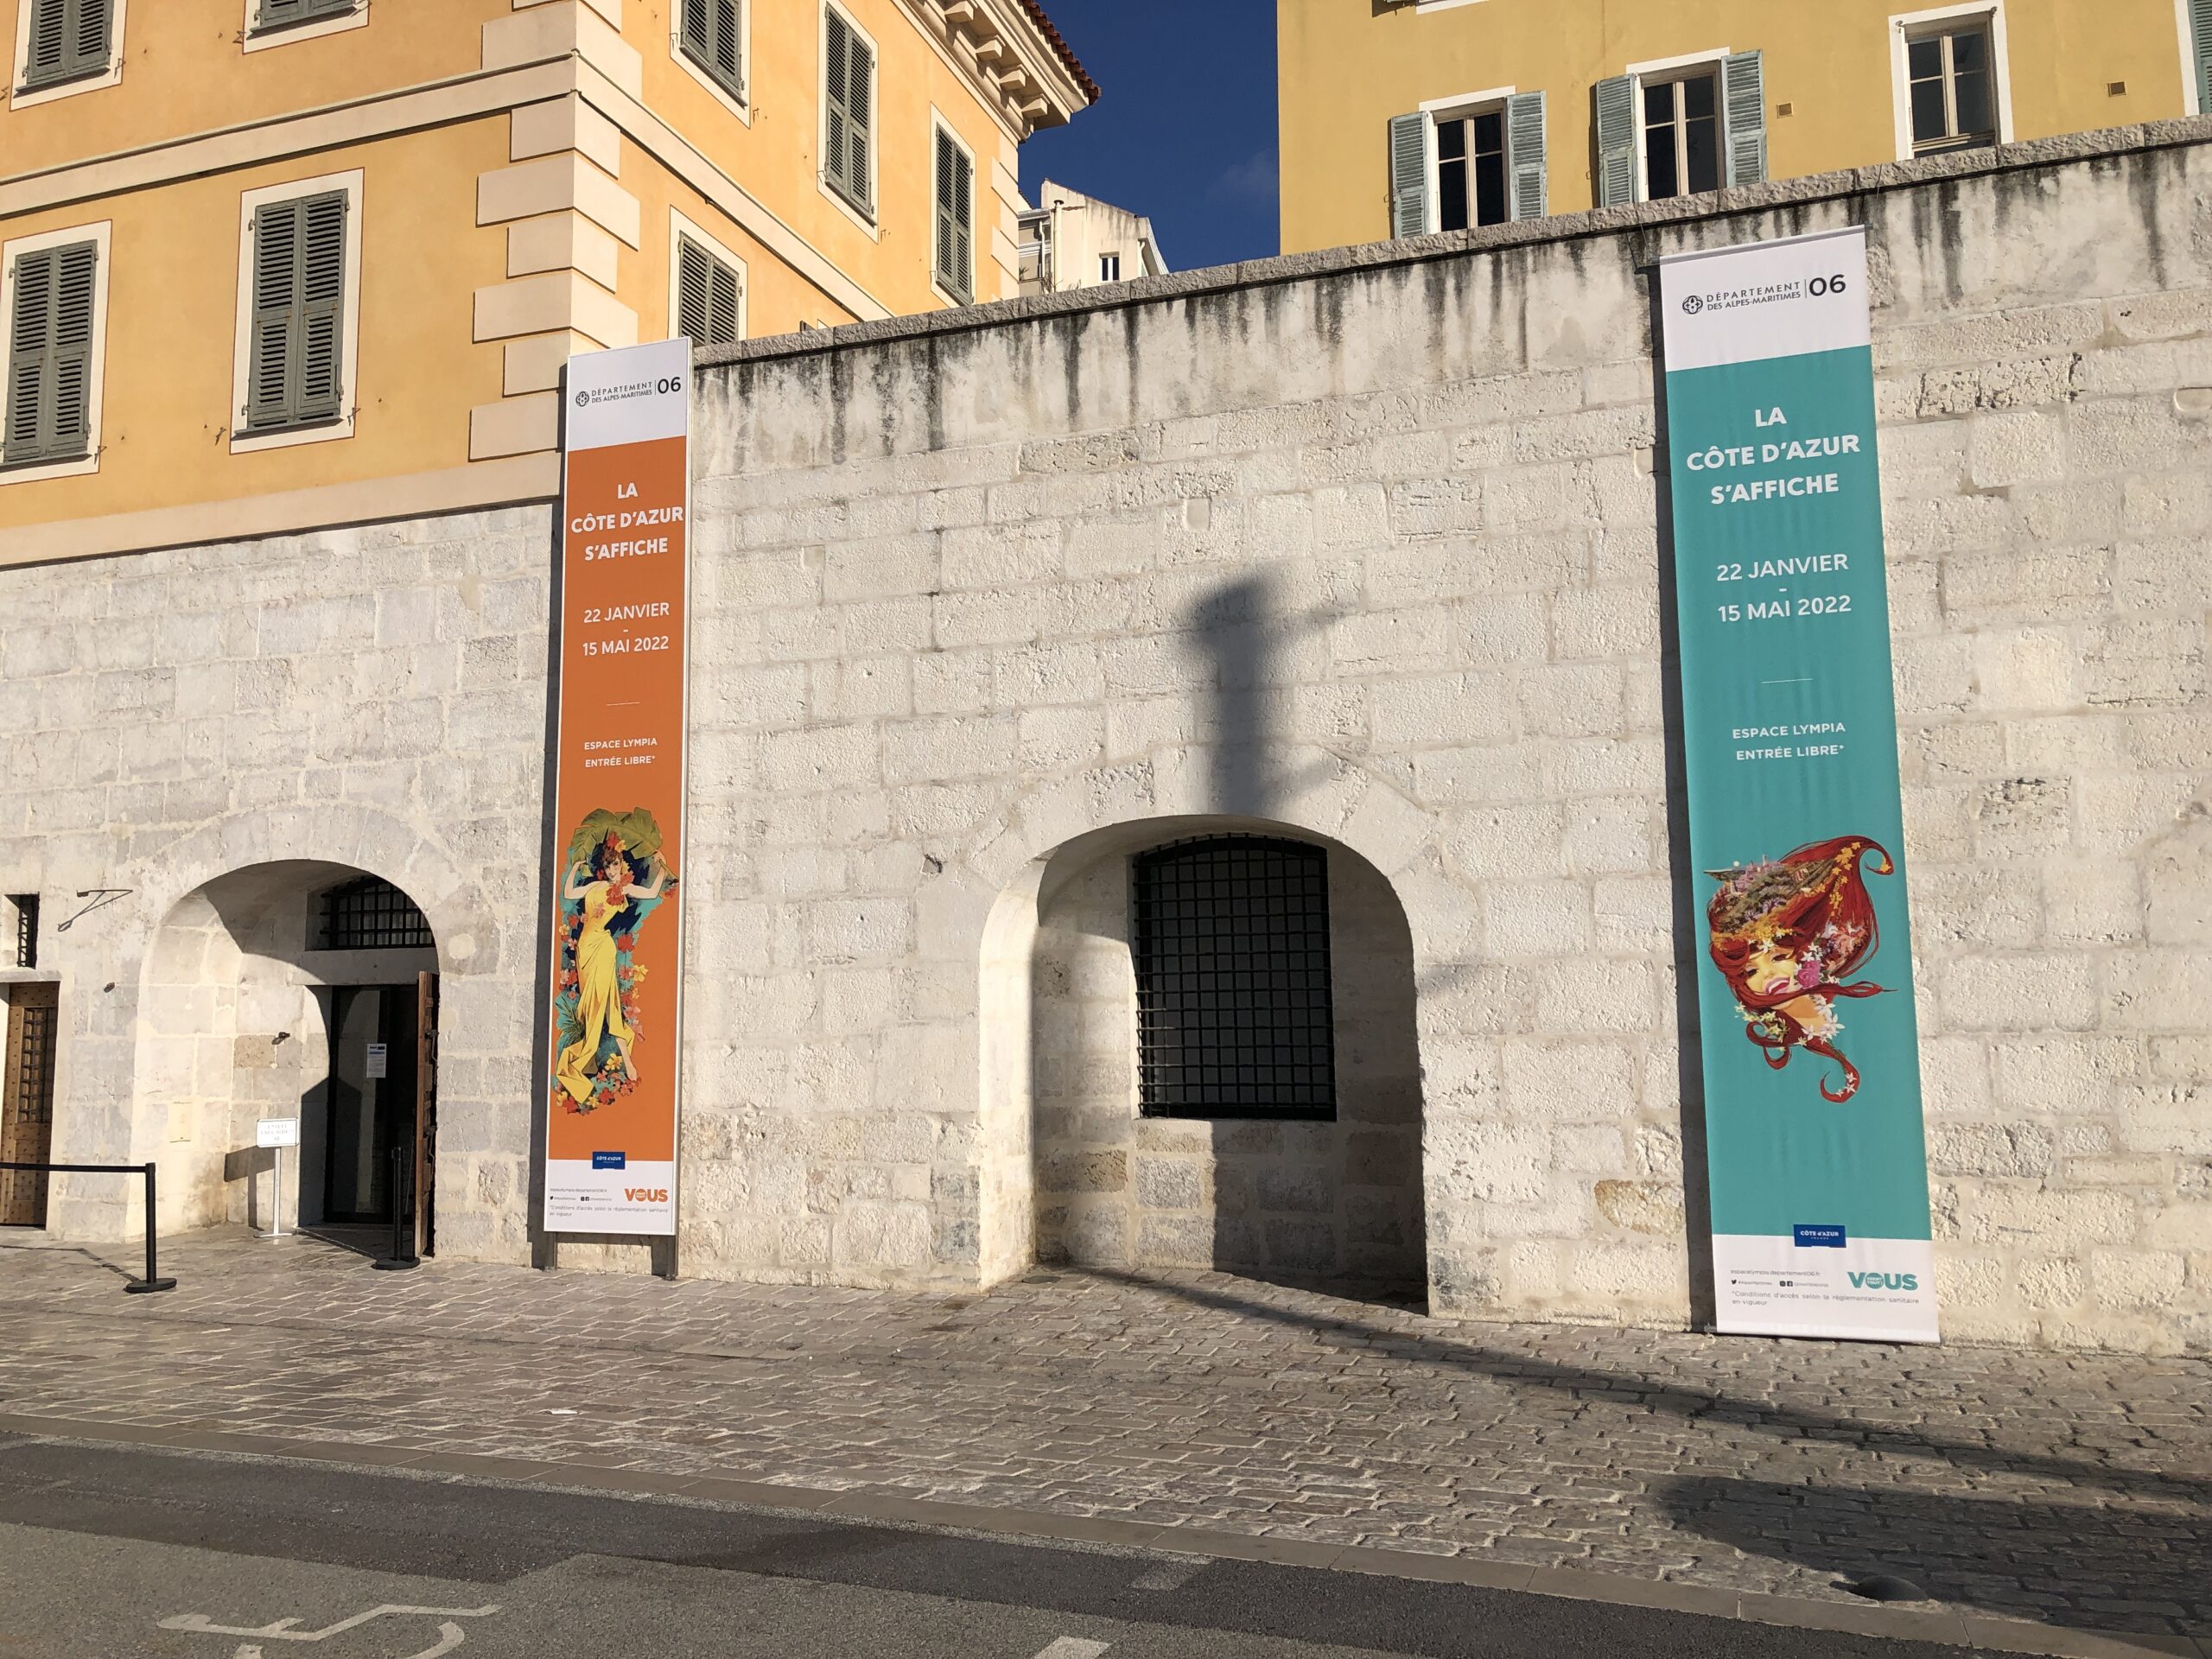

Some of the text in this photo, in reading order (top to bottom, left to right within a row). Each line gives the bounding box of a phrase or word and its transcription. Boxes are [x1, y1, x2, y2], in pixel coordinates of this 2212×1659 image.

[1707, 281, 1801, 302] DÉPARTEMENT
[1808, 274, 1847, 296] 06
[1707, 290, 1801, 311] DES ALPES-MARITIMES
[591, 381, 652, 397] DÉPARTEMENT
[603, 389, 652, 402] ALPES-MARITIMES
[658, 377, 681, 394] 06
[1755, 407, 1787, 427] LA
[1687, 434, 1860, 471] CÔTE D'AZUR
[617, 482, 639, 499] LA
[1711, 473, 1839, 505] S'AFFICHE
[571, 506, 683, 533] CÔTE D'AZUR
[584, 537, 668, 561] S'AFFICHE
[1717, 553, 1849, 582] 22 JANVIER
[583, 602, 670, 623] 22 JANVIER
[1718, 594, 1852, 622] 15 MAI 2022
[582, 636, 669, 656] 15 MAI 2022
[1732, 722, 1846, 739] ESPACE LYMPIA
[584, 738, 658, 750] ESPACE LYMPIA
[1736, 747, 1792, 760] ENTRÉE
[585, 756, 622, 767] ENTRÉE
[625, 1188, 669, 1203] VOUS
[1847, 1272, 1918, 1291] VOUS
